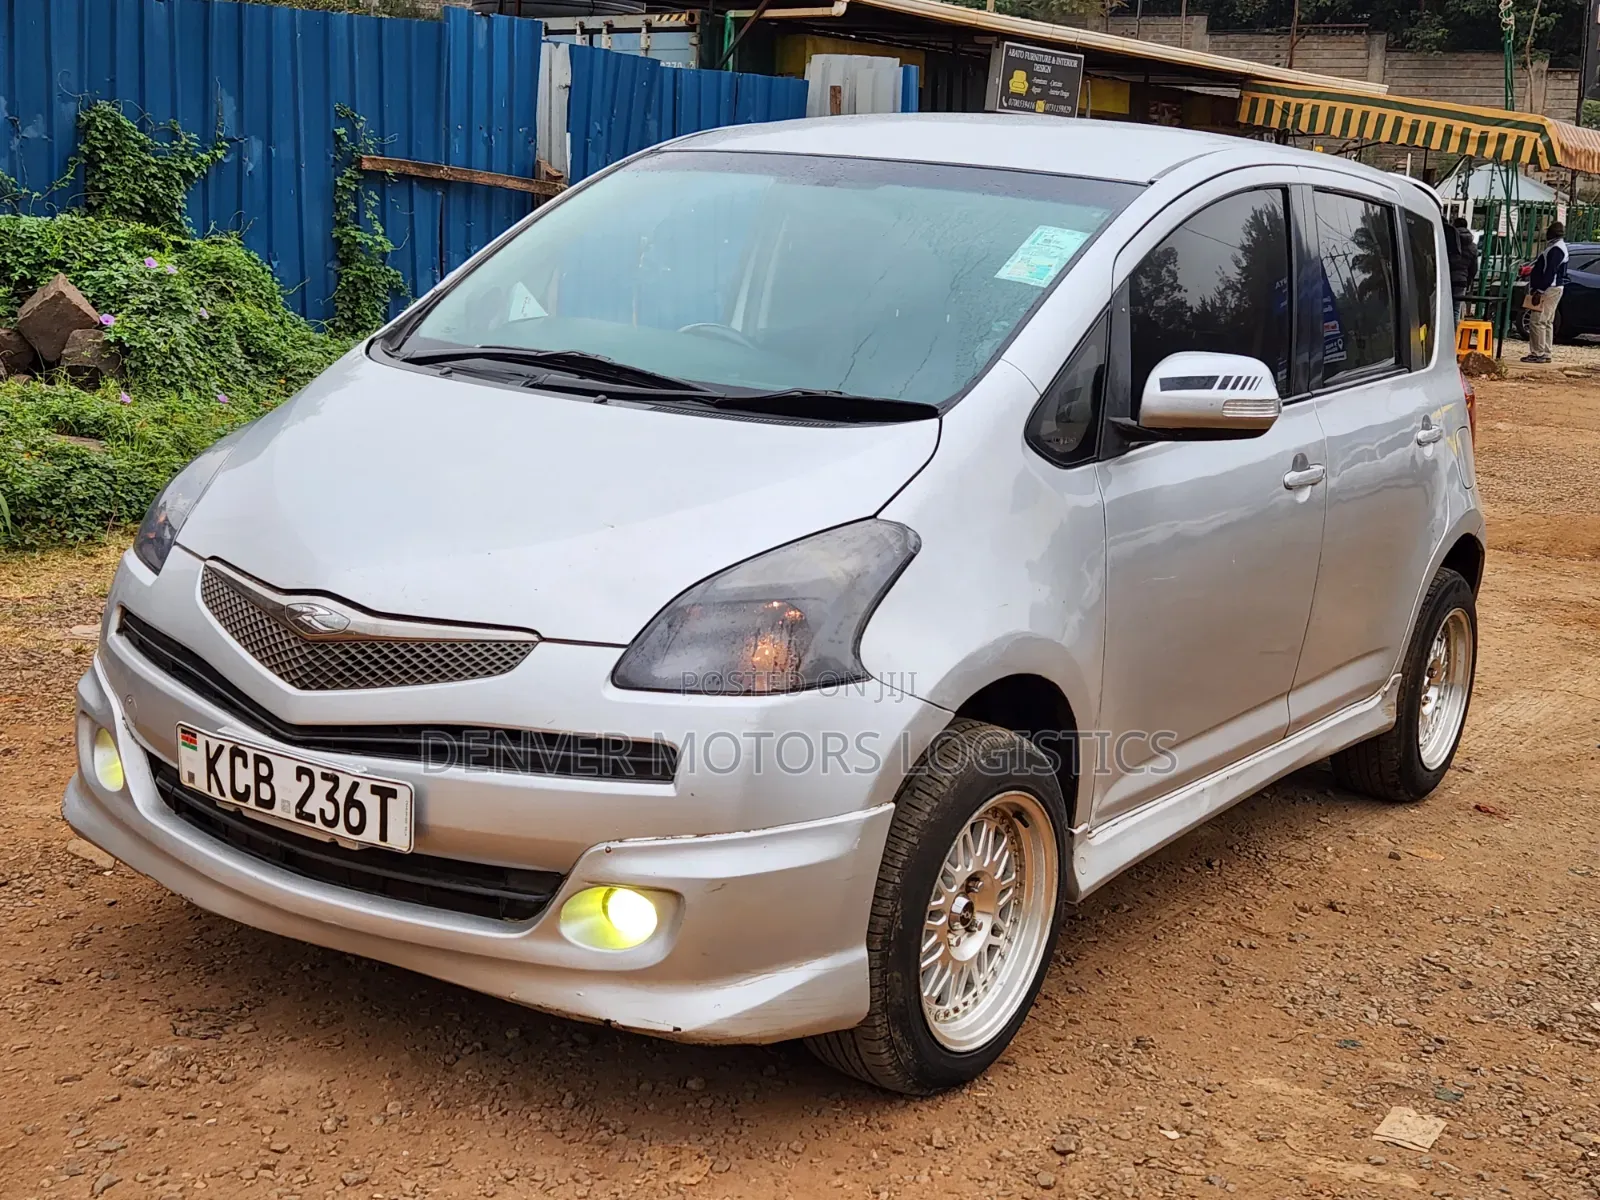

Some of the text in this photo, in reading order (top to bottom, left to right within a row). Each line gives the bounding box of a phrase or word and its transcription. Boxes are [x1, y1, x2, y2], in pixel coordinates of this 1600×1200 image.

[1025, 51, 1051, 63] FURNITURE
[1056, 57, 1078, 67] INTERIOR
[1034, 63, 1052, 73] DESIGN
[205, 739, 276, 811] KCB
[295, 765, 398, 843] 236T
